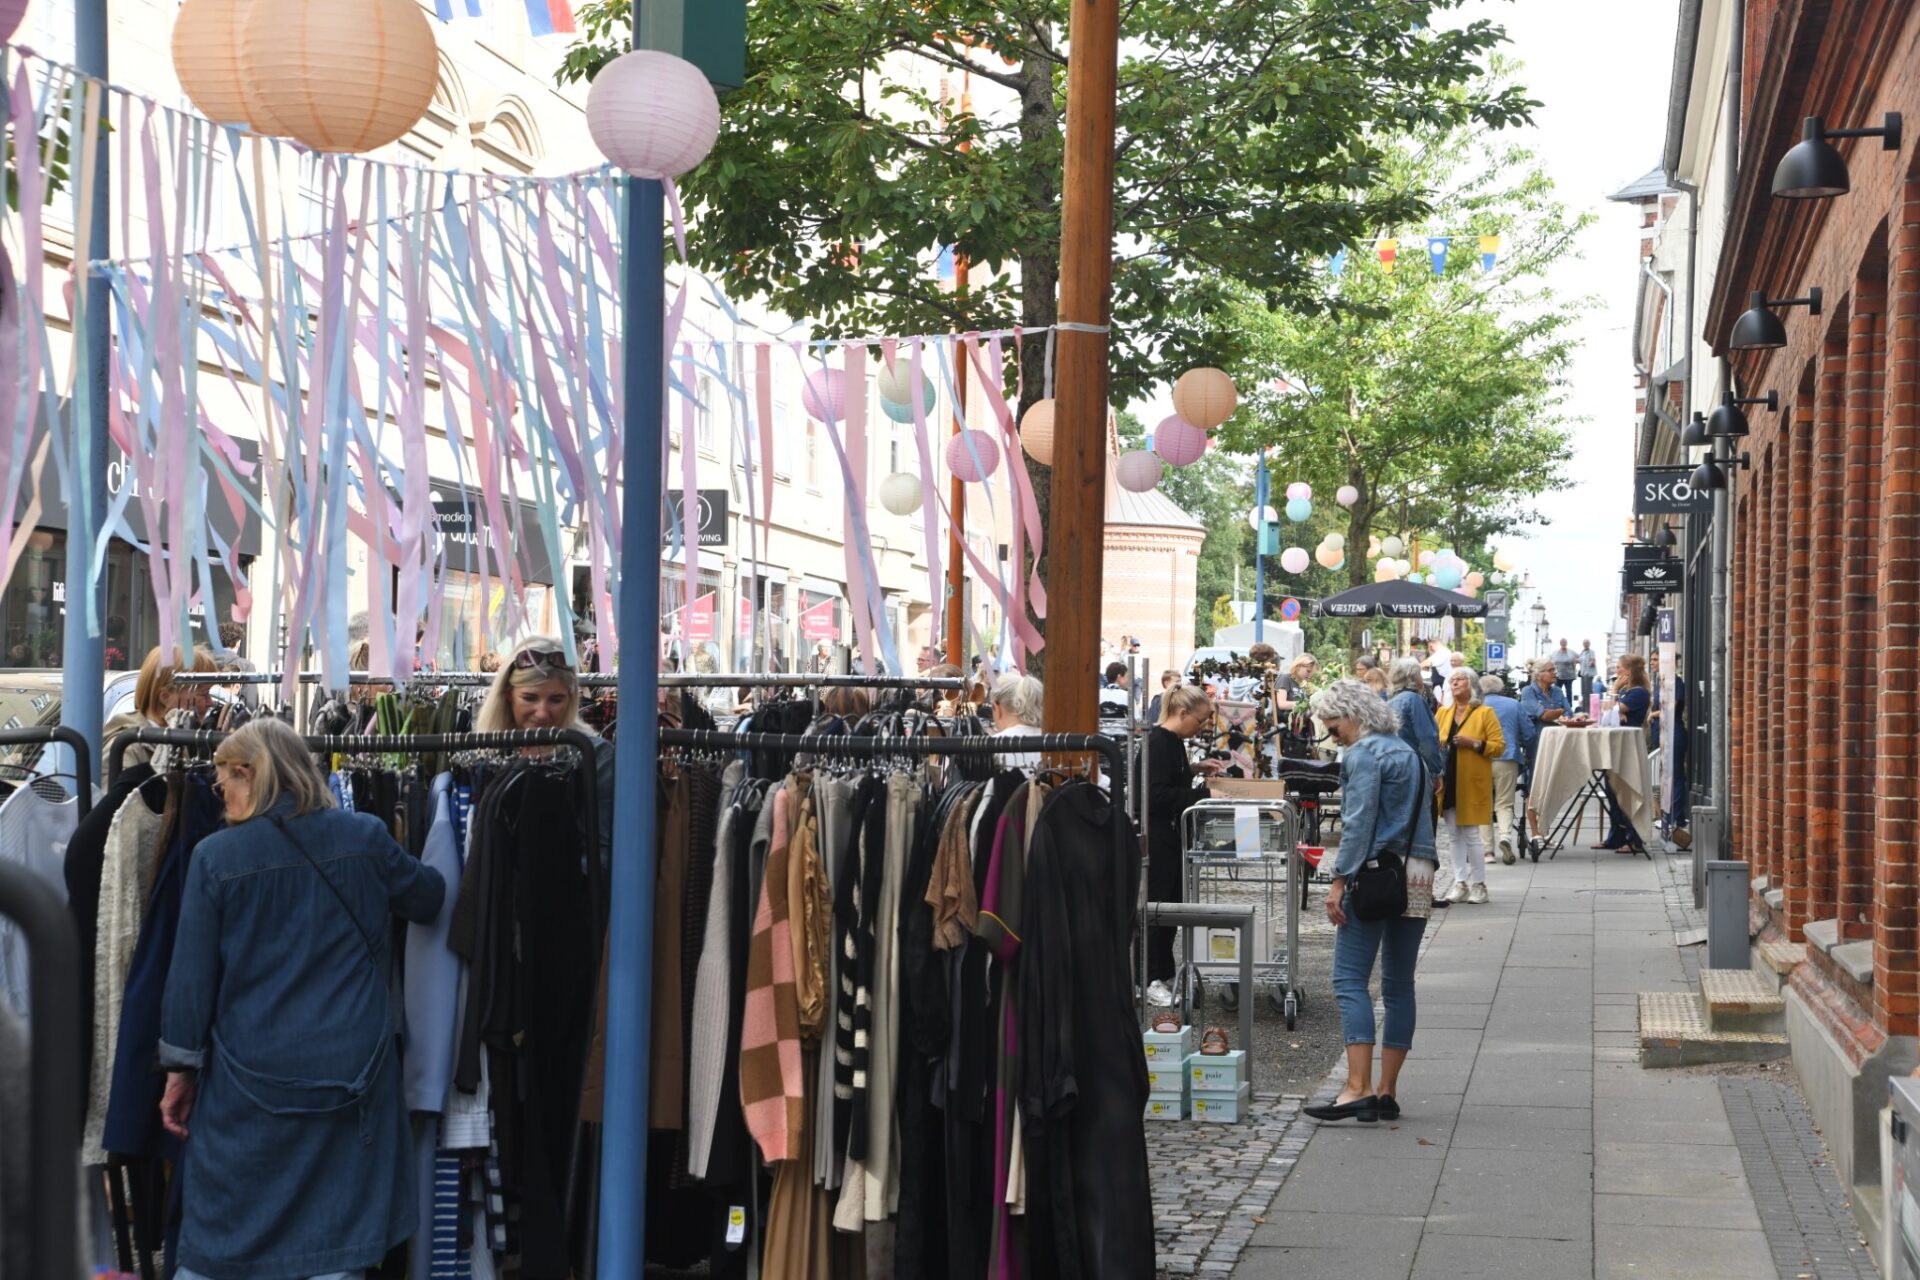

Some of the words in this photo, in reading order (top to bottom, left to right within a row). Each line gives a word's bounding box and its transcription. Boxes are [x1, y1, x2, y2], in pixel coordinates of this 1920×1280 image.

[1645, 478, 1709, 501] SKÖN
[1491, 646, 1501, 657] P
[1205, 1071, 1222, 1081] pair
[1205, 1103, 1222, 1112] pair
